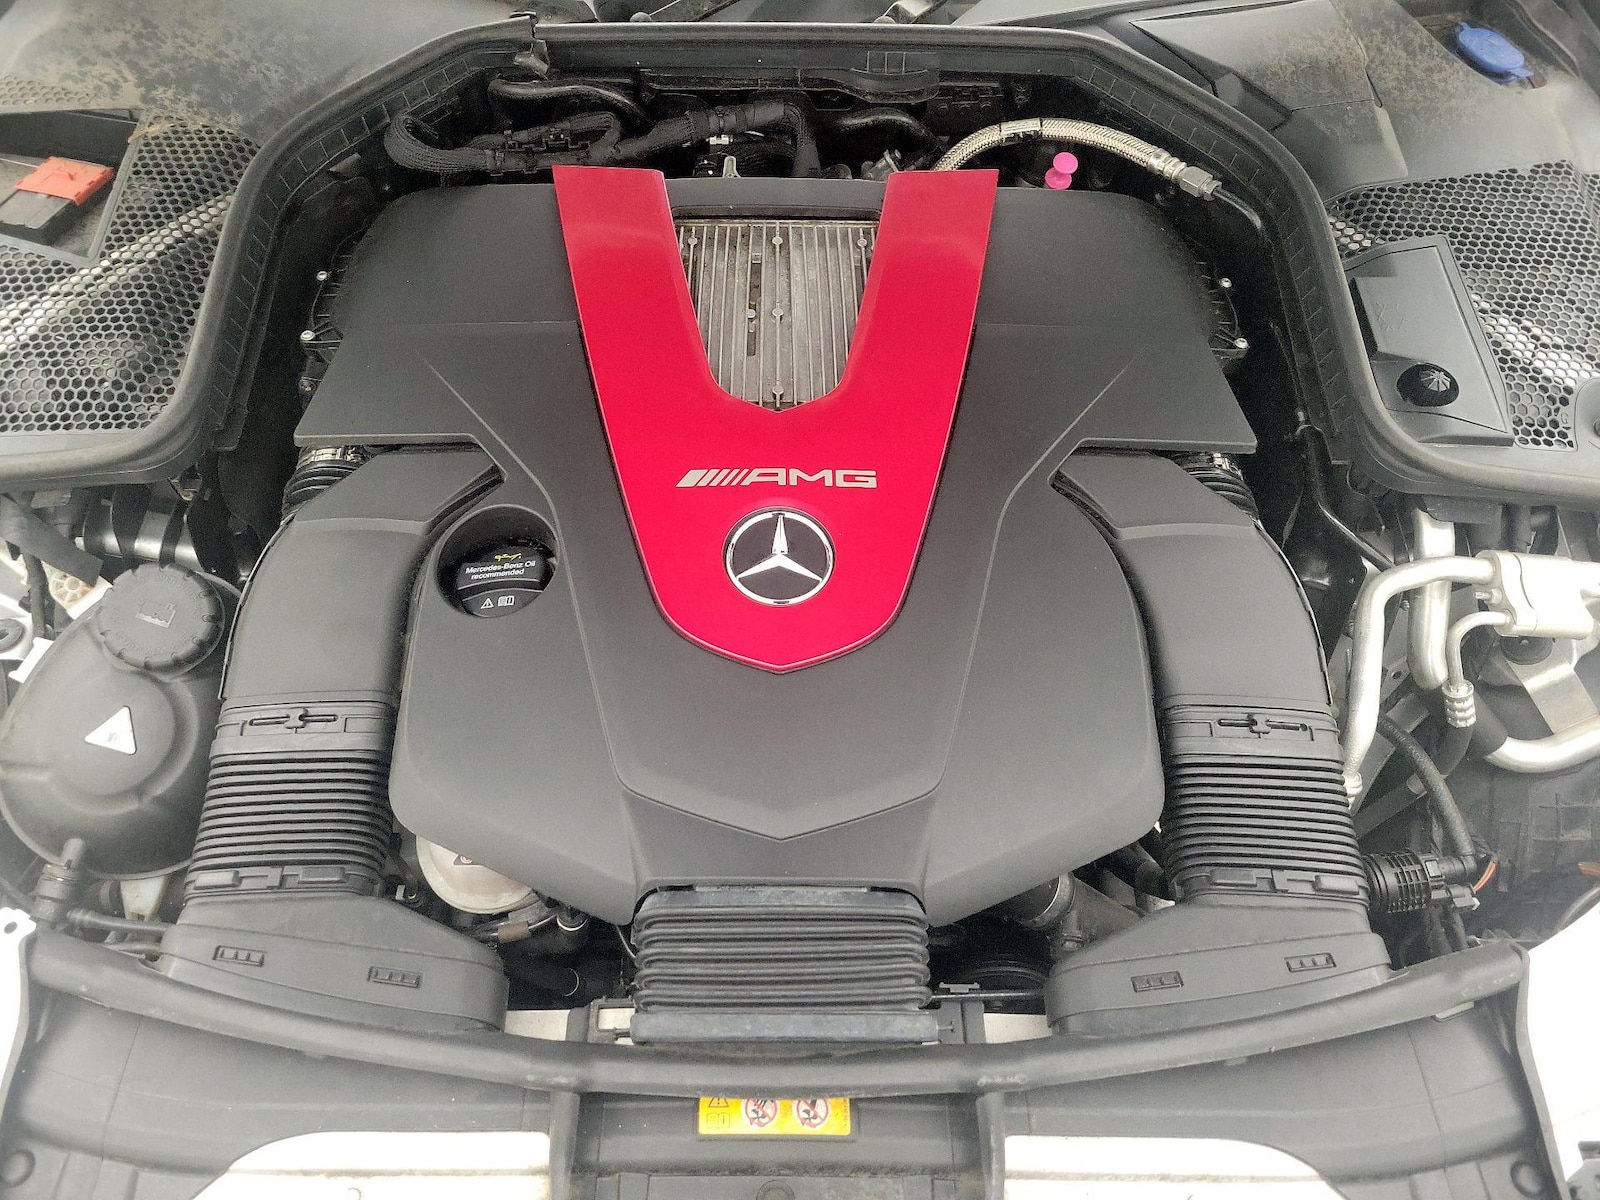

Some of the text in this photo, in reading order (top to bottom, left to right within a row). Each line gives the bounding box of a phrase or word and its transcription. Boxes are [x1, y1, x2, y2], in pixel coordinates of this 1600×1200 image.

[740, 468, 878, 488] AMG
[465, 560, 536, 574] Mercedes-Benz Oil
[471, 568, 525, 580] recommended
